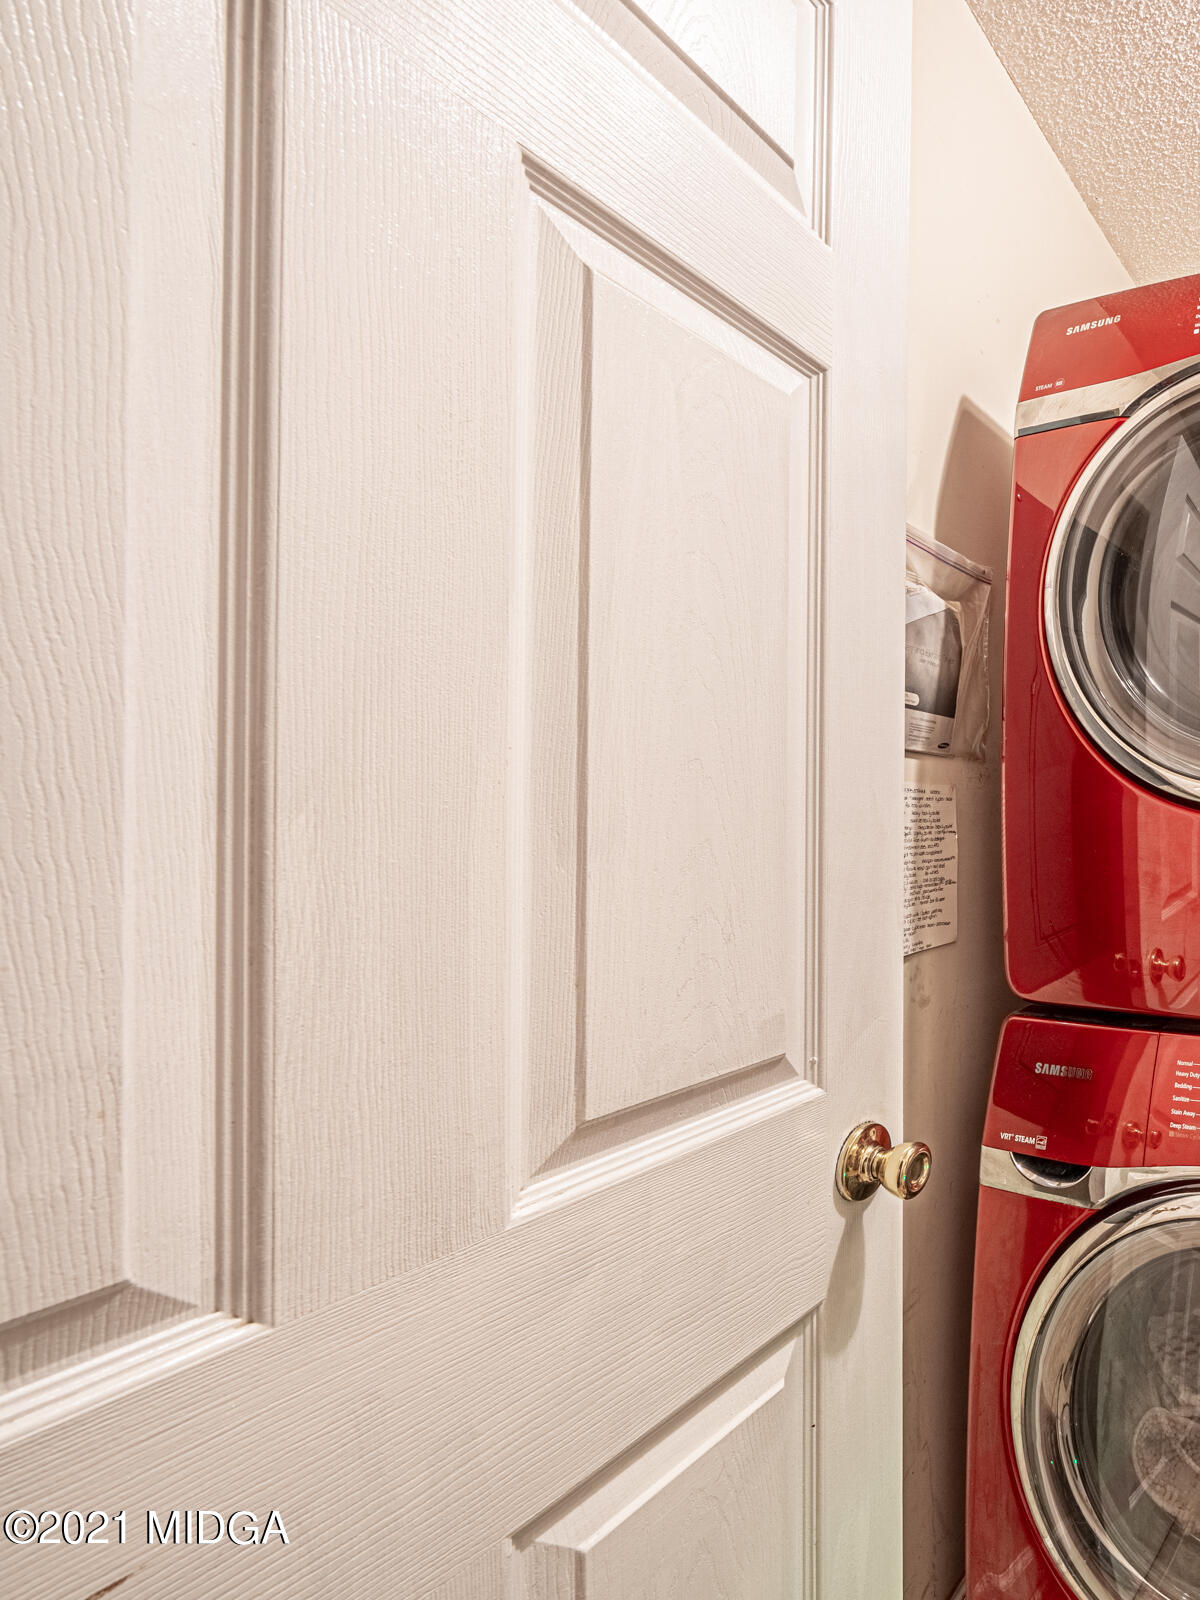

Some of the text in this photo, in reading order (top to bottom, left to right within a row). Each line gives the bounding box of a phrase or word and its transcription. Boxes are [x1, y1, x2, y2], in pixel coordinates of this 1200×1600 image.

[1066, 315, 1121, 336] SAMSUNG
[1035, 383, 1053, 392] STEAM
[1177, 1059, 1193, 1067] Normal
[1035, 1062, 1093, 1080] SAMSUNG
[1176, 1070, 1200, 1079] Heavy Duty
[1174, 1081, 1193, 1091] Bedding
[1014, 1134, 1036, 1145] STEAM
